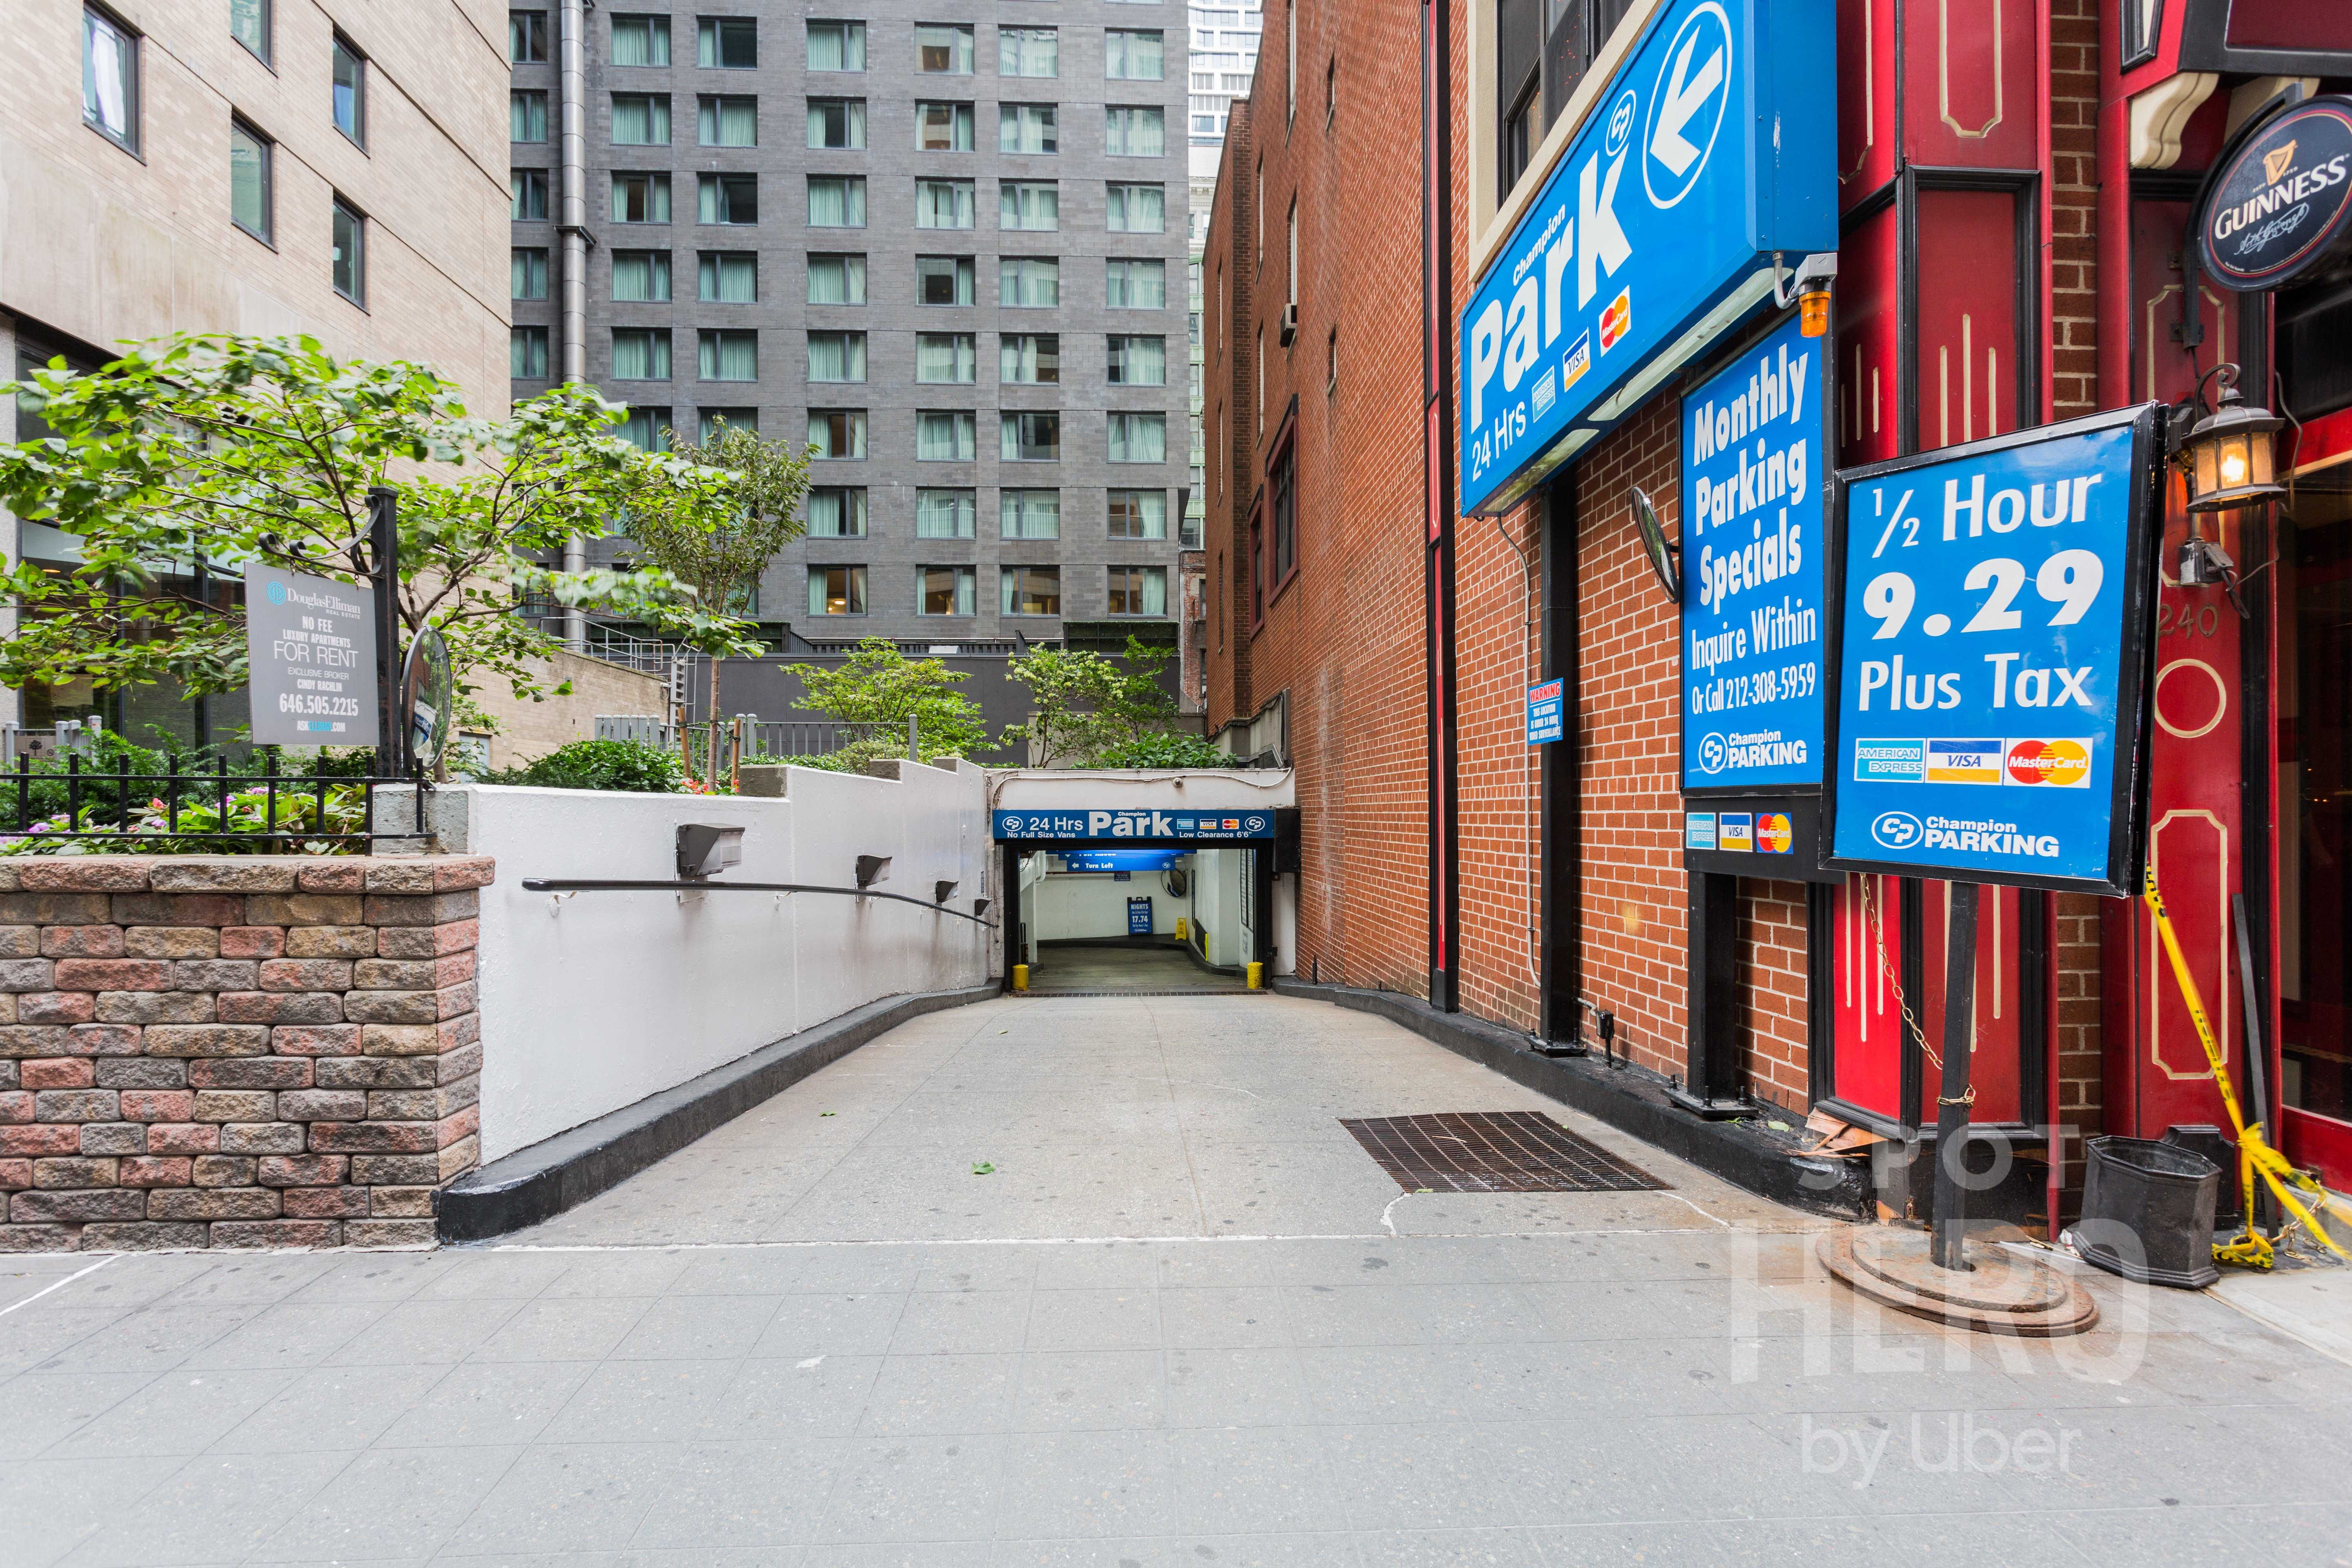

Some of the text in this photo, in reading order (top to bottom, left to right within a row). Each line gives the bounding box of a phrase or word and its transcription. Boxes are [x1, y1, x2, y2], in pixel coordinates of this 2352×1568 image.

[2215, 155, 2346, 239] GUINNESS
[1513, 204, 1566, 287] Champion
[1471, 142, 1633, 434] Park
[1601, 305, 1628, 340] MasterCard
[1568, 349, 1584, 374] VISA
[1533, 377, 1552, 401] AMERICAN
[1537, 388, 1554, 410] EXPRESS
[1694, 343, 1808, 466] Monthly
[1472, 400, 1526, 483] 24 Hrs
[1696, 438, 1806, 537] Parking
[1943, 473, 2102, 541] Hour
[1700, 507, 1802, 615] Specials
[1863, 549, 2104, 640] 9.29
[302, 616, 333, 633] NO FEE
[2158, 603, 2219, 639] 240
[283, 629, 350, 648] LUXURY APARTMENTS
[1692, 595, 1816, 676] Inquire Within
[274, 641, 359, 668] FOR RENT
[288, 667, 349, 680] EXCLUSIVE BROKER
[297, 679, 342, 692] CINDY RACHLIN
[1859, 652, 2093, 711] Plus Tax
[1530, 682, 1561, 704] WARNING
[1692, 662, 1816, 715] Or Call 212-308-5959
[279, 693, 359, 716] 646.505.2215
[1541, 703, 1556, 715] LOCATION
[1728, 728, 1781, 748] Champion
[1728, 739, 1807, 769] PARKING
[1858, 748, 1918, 759] AMERICAN
[1947, 755, 1981, 768] VISA
[2009, 756, 2087, 769] MasterCard
[1870, 762, 1922, 773] EXPRESS
[1029, 817, 1083, 831] 24 Hrs
[1089, 811, 1174, 836] Park
[1688, 821, 1713, 829] AMERICAN
[1728, 826, 1743, 837] VISA
[1758, 828, 1790, 838] MasterCard
[1926, 816, 2017, 833] Champion
[1925, 829, 2059, 858] PARKING
